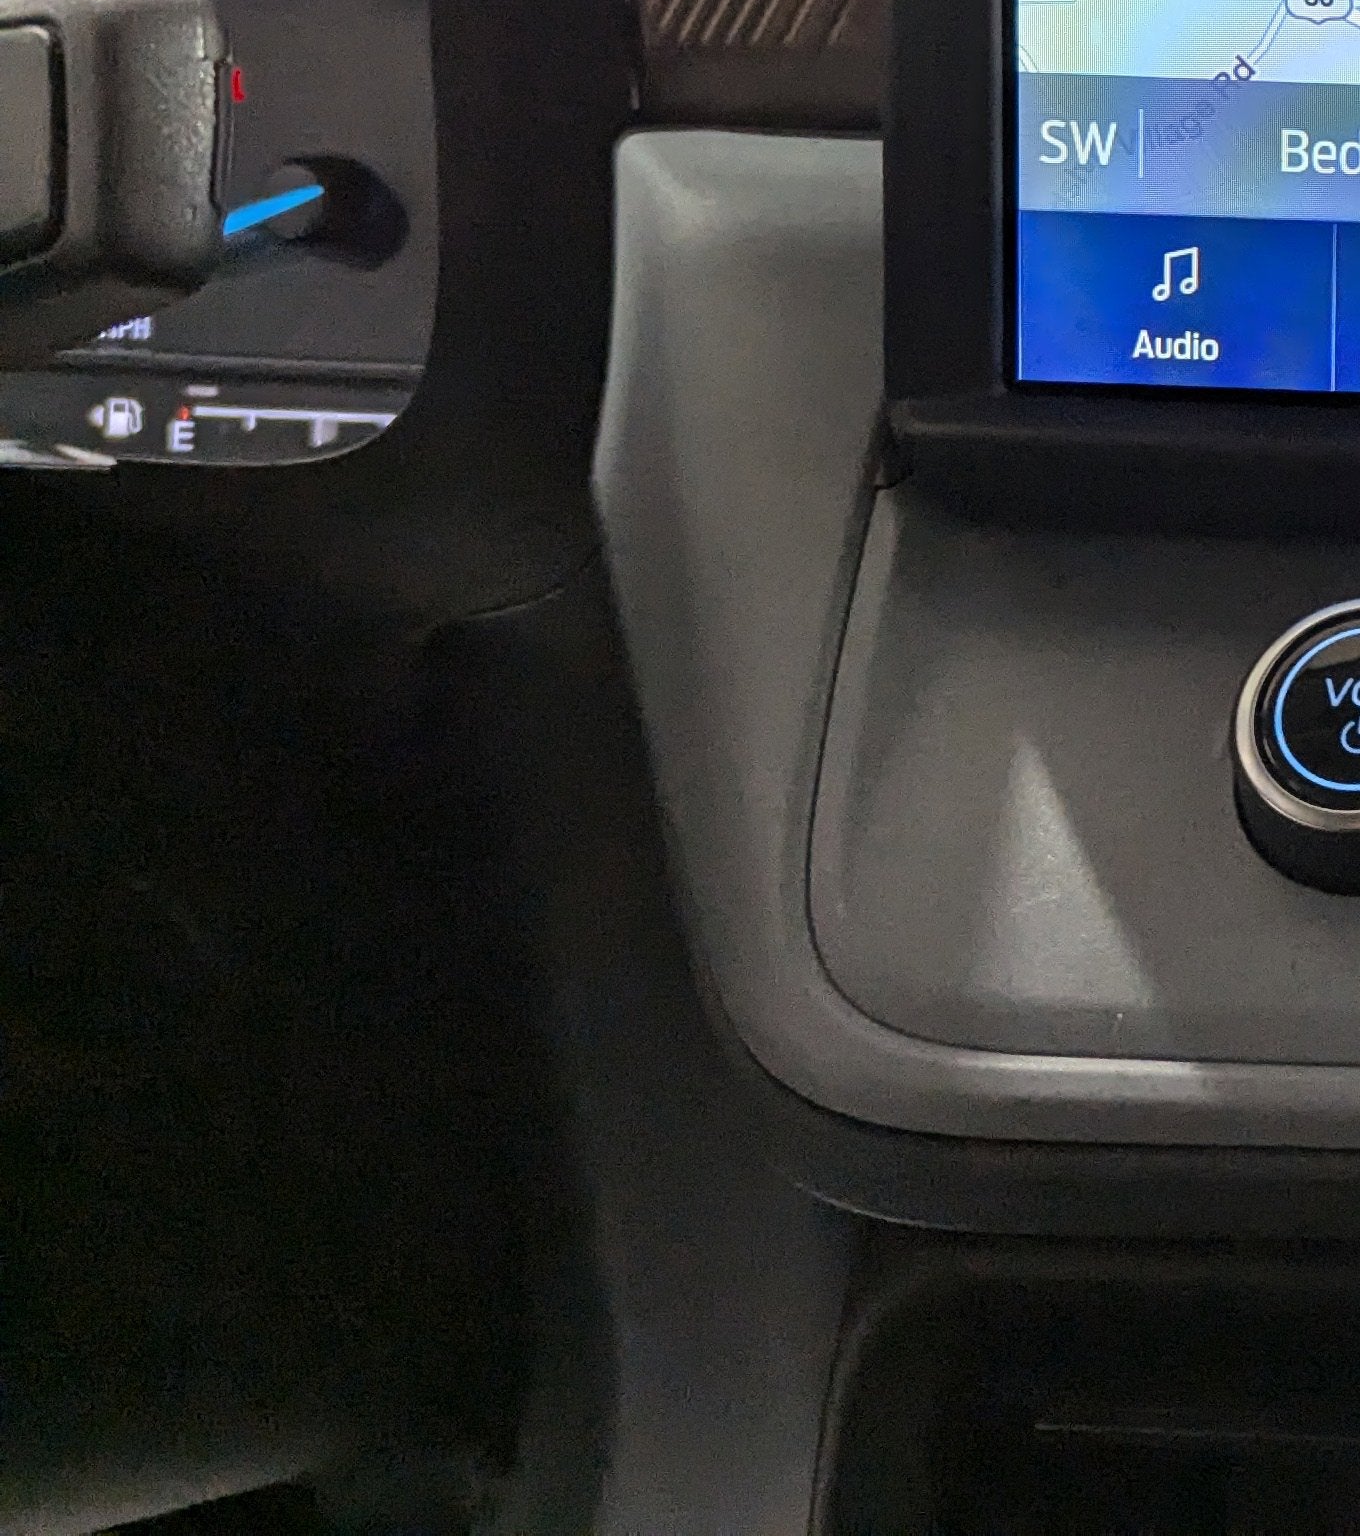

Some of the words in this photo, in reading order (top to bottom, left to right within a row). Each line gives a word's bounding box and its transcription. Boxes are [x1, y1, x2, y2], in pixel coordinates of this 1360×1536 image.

[1039, 119, 1117, 166] SW
[1132, 330, 1220, 363] Audio
[167, 420, 195, 452] E
